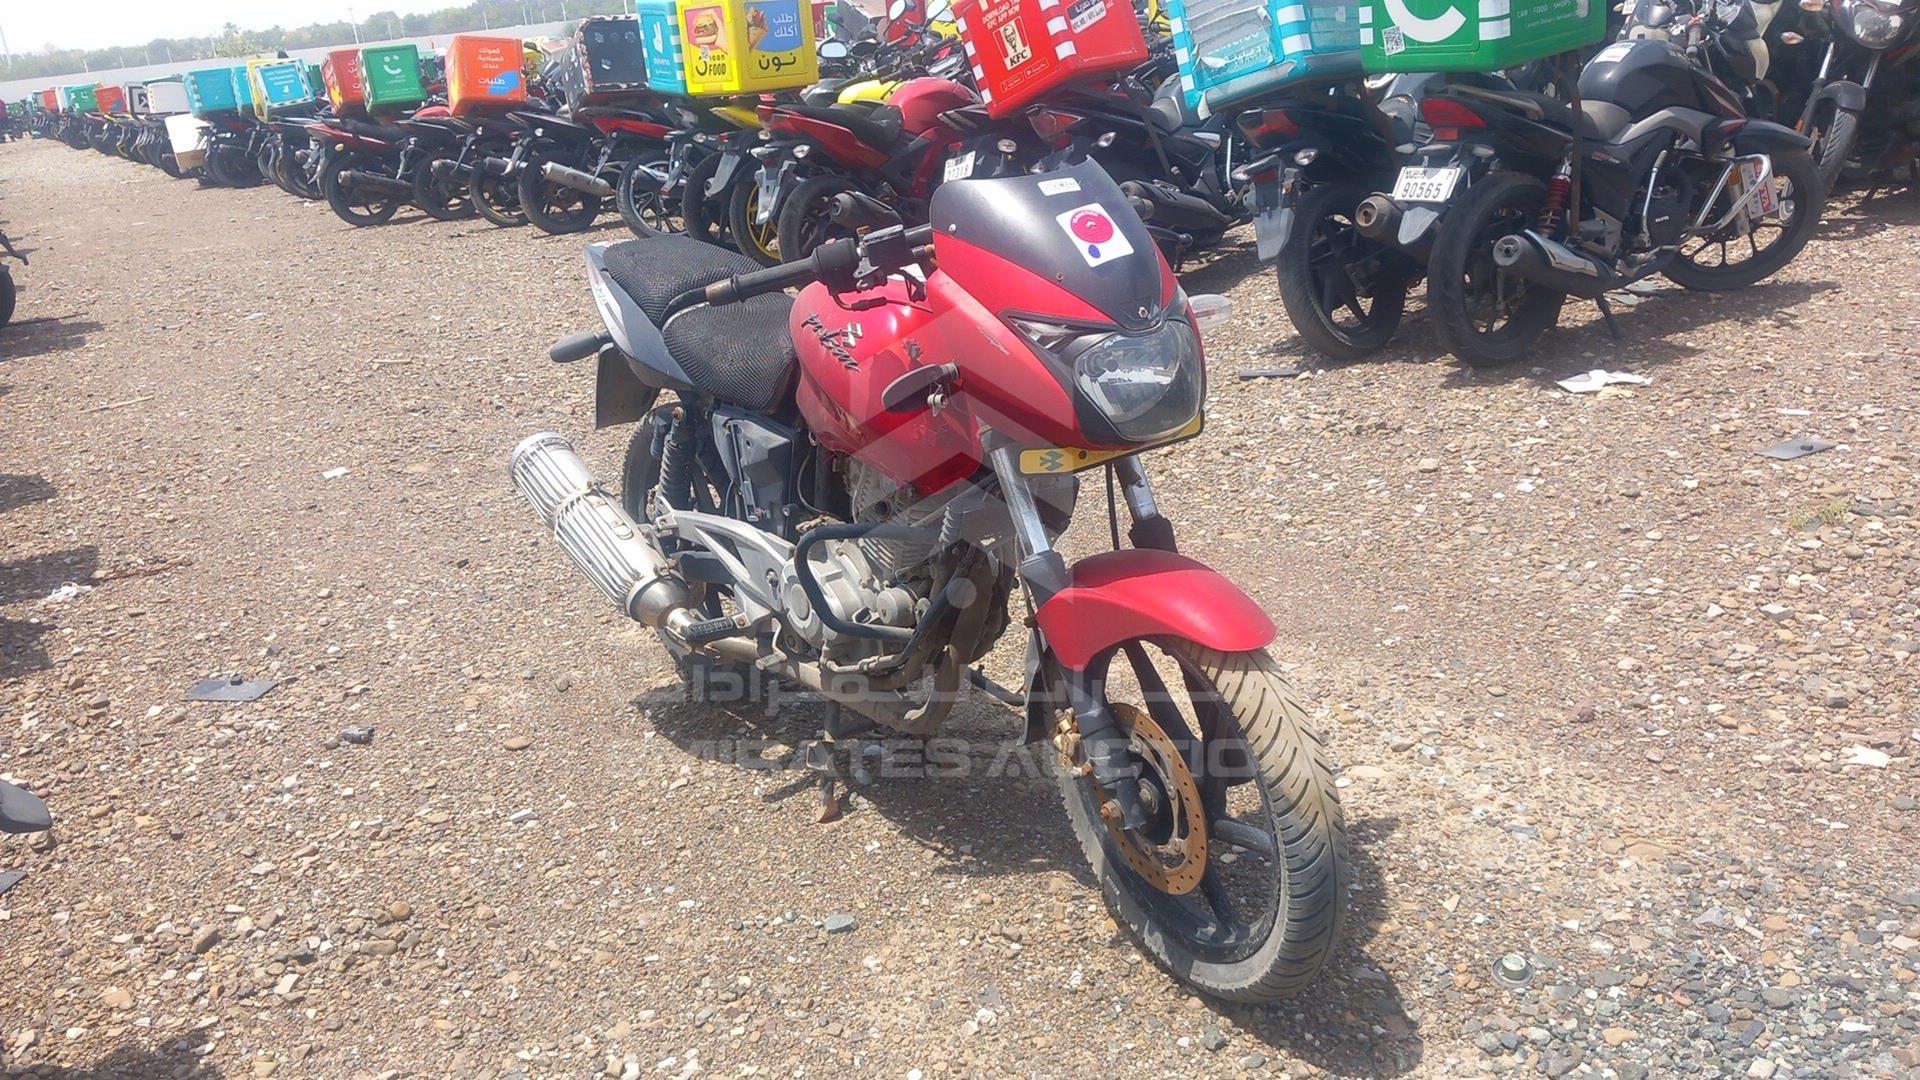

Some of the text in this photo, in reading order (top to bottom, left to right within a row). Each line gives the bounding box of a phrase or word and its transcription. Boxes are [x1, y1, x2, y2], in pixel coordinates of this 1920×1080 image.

[1533, 4, 1547, 14] FOOD
[773, 13, 797, 24] اطلب
[774, 25, 799, 38] أكلك
[758, 52, 797, 72] نون
[1009, 49, 1028, 67] KFC
[708, 63, 727, 76] FOOD
[478, 77, 506, 85] طلبات
[1401, 181, 1443, 199] 90565
